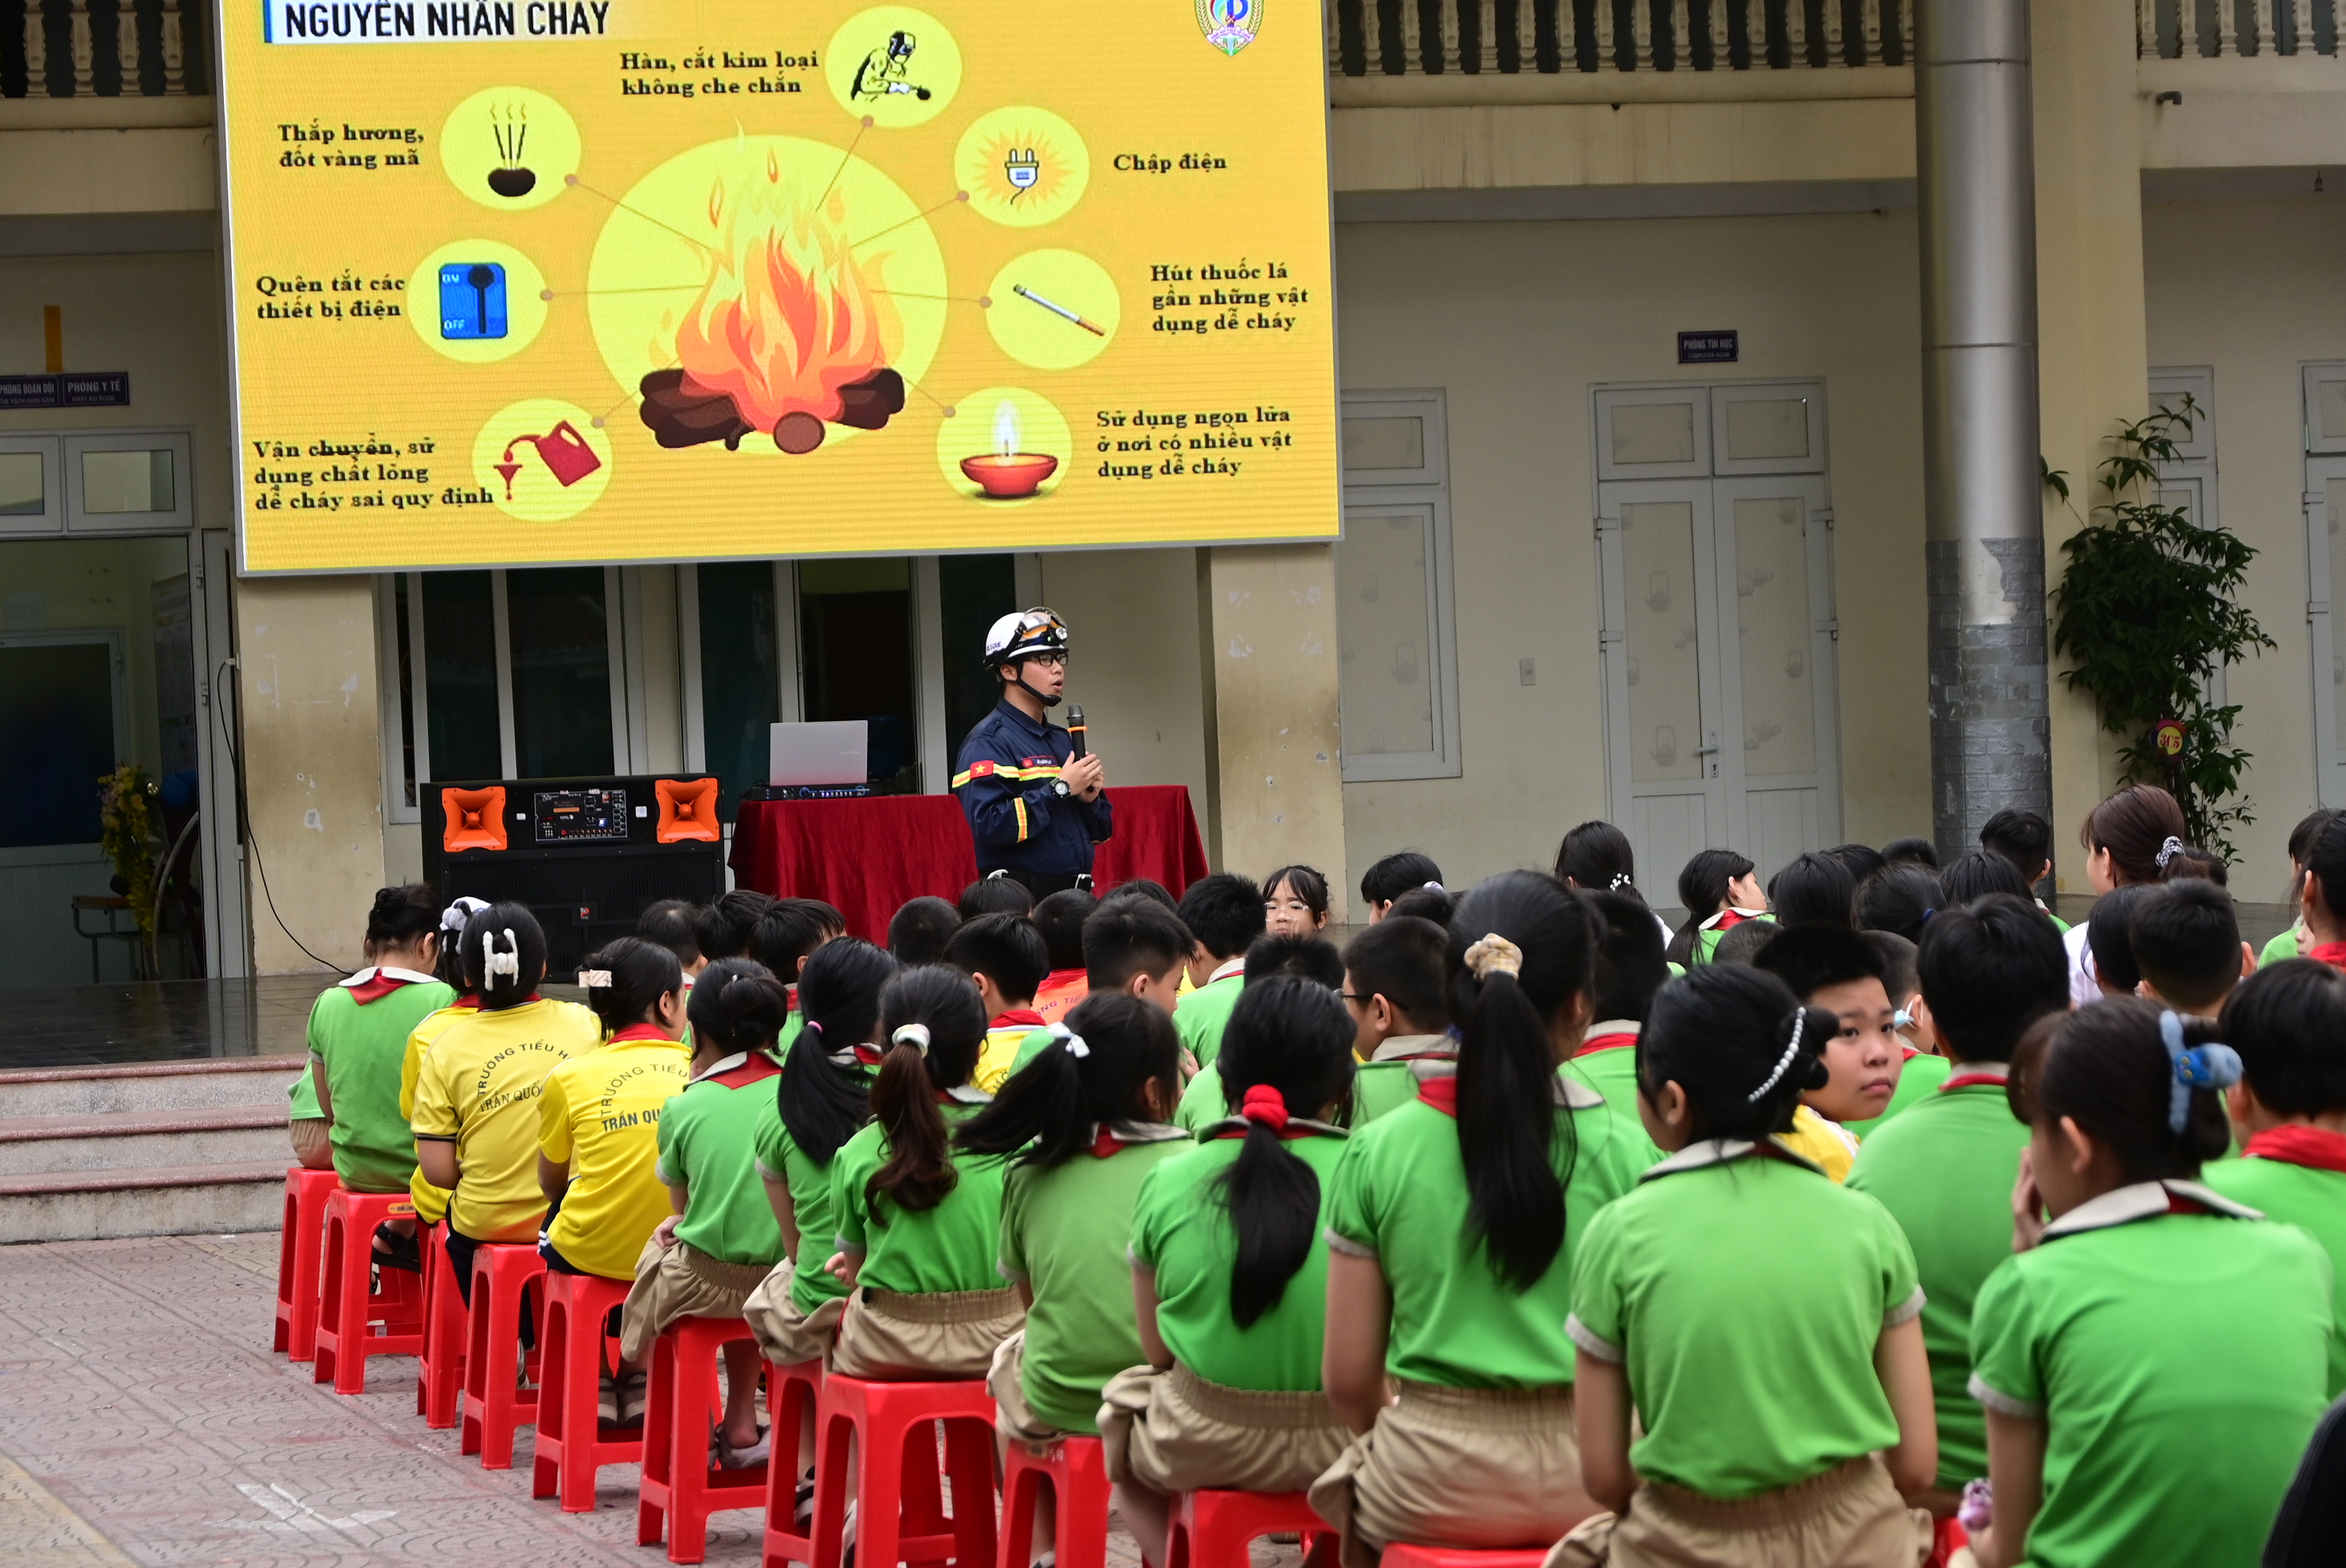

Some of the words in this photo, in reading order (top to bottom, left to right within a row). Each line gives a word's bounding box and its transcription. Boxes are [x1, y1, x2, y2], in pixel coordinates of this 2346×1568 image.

[619, 52, 676, 73] Hàn,
[683, 45, 716, 69] cắt
[722, 51, 768, 69] kim
[775, 50, 819, 71] loại
[622, 78, 695, 98] không
[701, 76, 740, 94] che
[747, 70, 802, 93] chắn
[277, 118, 335, 145] Thắp
[342, 123, 425, 143] hương,
[280, 143, 316, 167] đốt
[322, 149, 378, 170] vàng
[384, 148, 420, 166] mã
[1113, 153, 1172, 174] Chập
[1179, 152, 1227, 173] điện
[1150, 264, 1194, 281] Hút
[1200, 257, 1261, 280] thuốc
[1267, 262, 1288, 279] lá
[256, 275, 324, 297] Quên
[331, 268, 363, 291] tắt
[369, 273, 406, 291] các
[257, 295, 313, 319] thiết
[320, 300, 343, 321] bị
[349, 300, 401, 320] điện
[1152, 284, 1191, 311] gần
[1198, 288, 1271, 308] những
[1276, 287, 1308, 307] vật
[1152, 315, 1208, 335] dụng
[1214, 308, 1239, 330] dễ
[1246, 312, 1297, 331] cháy
[1708, 339, 1719, 349] TIN
[67, 379, 100, 393] PHÒNG
[101, 381, 108, 391] Y
[110, 377, 121, 391] TẾ
[1132, 410, 1187, 429] dụng
[1195, 411, 1249, 429] ngọn
[253, 440, 300, 461] Vận
[1116, 434, 1152, 451] nơi
[1159, 433, 1182, 450] có
[1189, 427, 1253, 449] nhiều
[1259, 430, 1292, 451] vật
[254, 468, 313, 487] dụng
[1097, 461, 1153, 480] dụng
[1159, 453, 1185, 475] dễ
[1191, 457, 1242, 476] cháy
[255, 484, 282, 510] dễ
[290, 490, 343, 512] cháy
[351, 489, 385, 508] sai
[391, 492, 434, 509] quy
[441, 487, 494, 508] định
[477, 1048, 516, 1098] TRƯỜNG
[519, 1038, 555, 1052] TIỂU
[513, 1079, 543, 1101] QUỐ
[600, 1066, 645, 1118] TRƯỜNG
[601, 1109, 638, 1132] TRẦN
